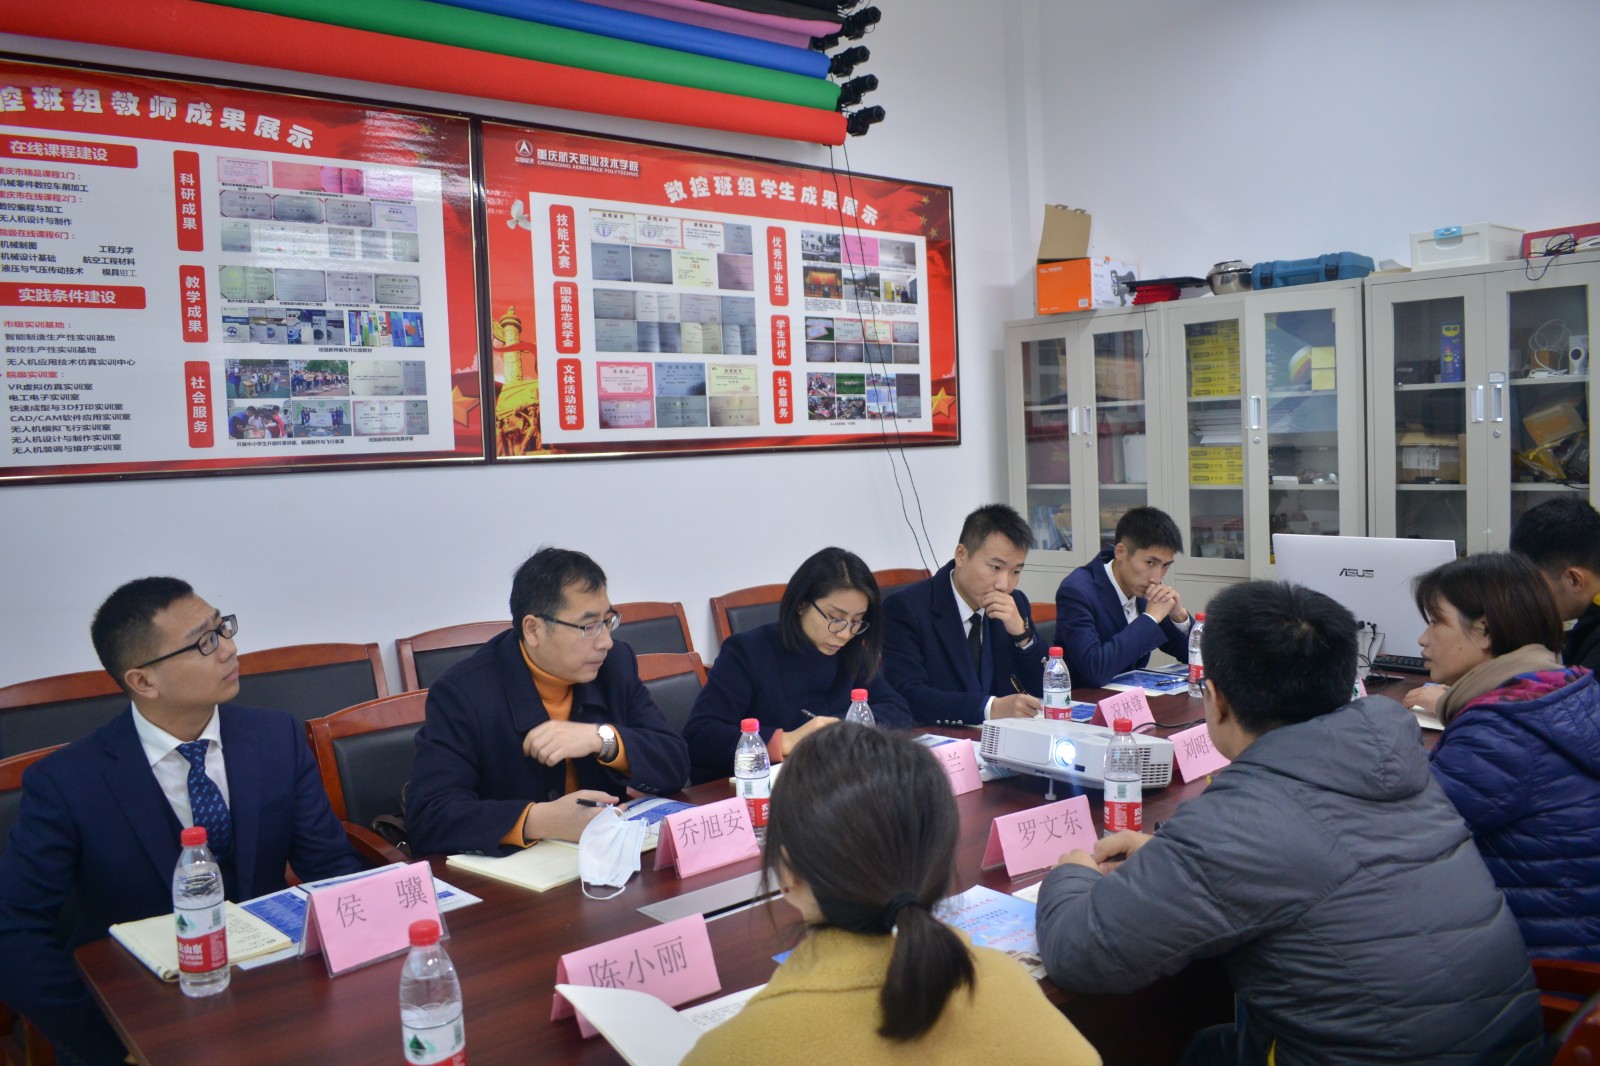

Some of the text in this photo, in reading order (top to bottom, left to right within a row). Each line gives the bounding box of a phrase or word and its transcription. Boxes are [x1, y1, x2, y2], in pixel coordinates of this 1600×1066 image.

[10, 140, 108, 161] 在线课程建设
[537, 148, 639, 172] 重庆航天职业技术学院
[572, 164, 603, 173] AEROSPACE
[604, 168, 639, 177] POLYTECHNIC
[180, 172, 197, 230] 科研成果
[664, 176, 878, 226] 数控班组学生成果展示
[0, 215, 72, 226] 无人机设计与制作
[0, 240, 37, 250] 机械制图
[556, 213, 571, 269] 技能大赛
[99, 245, 134, 254] 工程力学
[0, 253, 57, 262] 机械设计基础
[83, 256, 136, 266] 航空工程材料
[1, 264, 84, 275] 液压与气压传动技术
[772, 236, 784, 296] 优秀毕业生
[18, 287, 117, 304] 实践条件建设
[185, 276, 203, 333] 教学成果
[560, 286, 573, 348] 国家励志奖学金
[5, 333, 116, 342] 智能制造生产性实训基地
[776, 319, 786, 359] 学生评优
[5, 346, 97, 354] 数控生产性实训基地
[6, 358, 136, 366] 无人机应用技术仿真实训中心
[8, 383, 93, 391] VR虚拟仿真实训室
[9, 394, 80, 402] 电工电子实训室
[563, 364, 577, 425] 文体活动荣誉
[778, 377, 788, 418] 社会服务
[9, 403, 124, 412] 快速成型与3D打印实训室
[190, 376, 208, 433] 社会服务
[10, 413, 131, 422] CAD/CAM软件应用实训室
[11, 424, 111, 433] 无人机模拟飞行实训室
[11, 434, 122, 443] 无人机设计与制作实训室
[12, 444, 122, 454] 无人机装调与维护实训室
[1339, 568, 1374, 578] ASUS
[677, 808, 744, 848] 乔旭安
[1018, 809, 1082, 850] 罗文东
[336, 876, 428, 928] 侯 骥
[588, 936, 687, 989] 陈小丽
